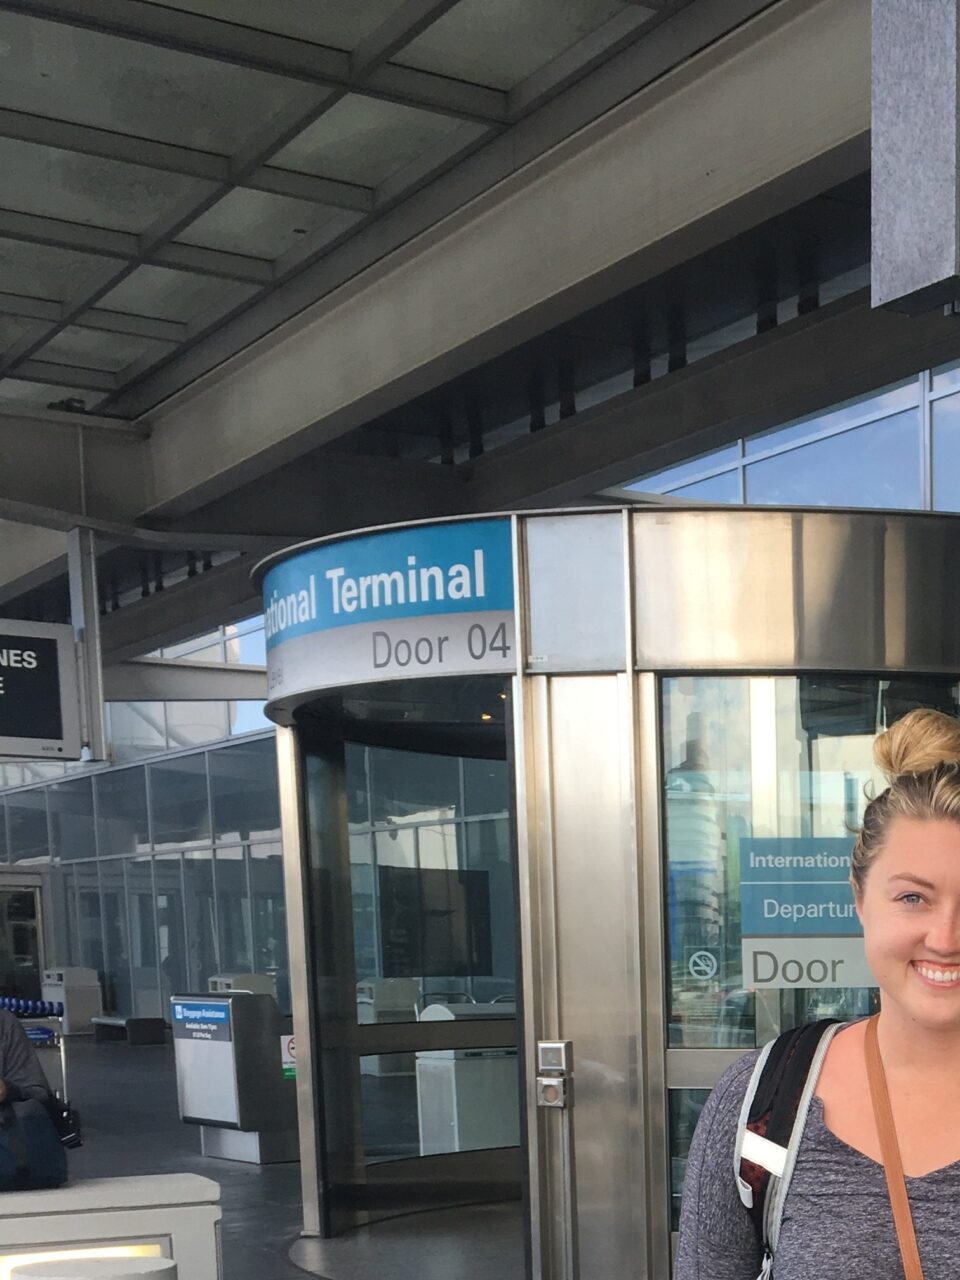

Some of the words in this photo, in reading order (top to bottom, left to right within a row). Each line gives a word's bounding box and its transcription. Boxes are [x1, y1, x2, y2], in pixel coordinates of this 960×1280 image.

[265, 574, 317, 638] ational
[325, 549, 486, 614] Terminal
[372, 630, 449, 669] Door
[468, 622, 512, 661] 04
[750, 852, 851, 868] Internation
[752, 951, 845, 983] Door
